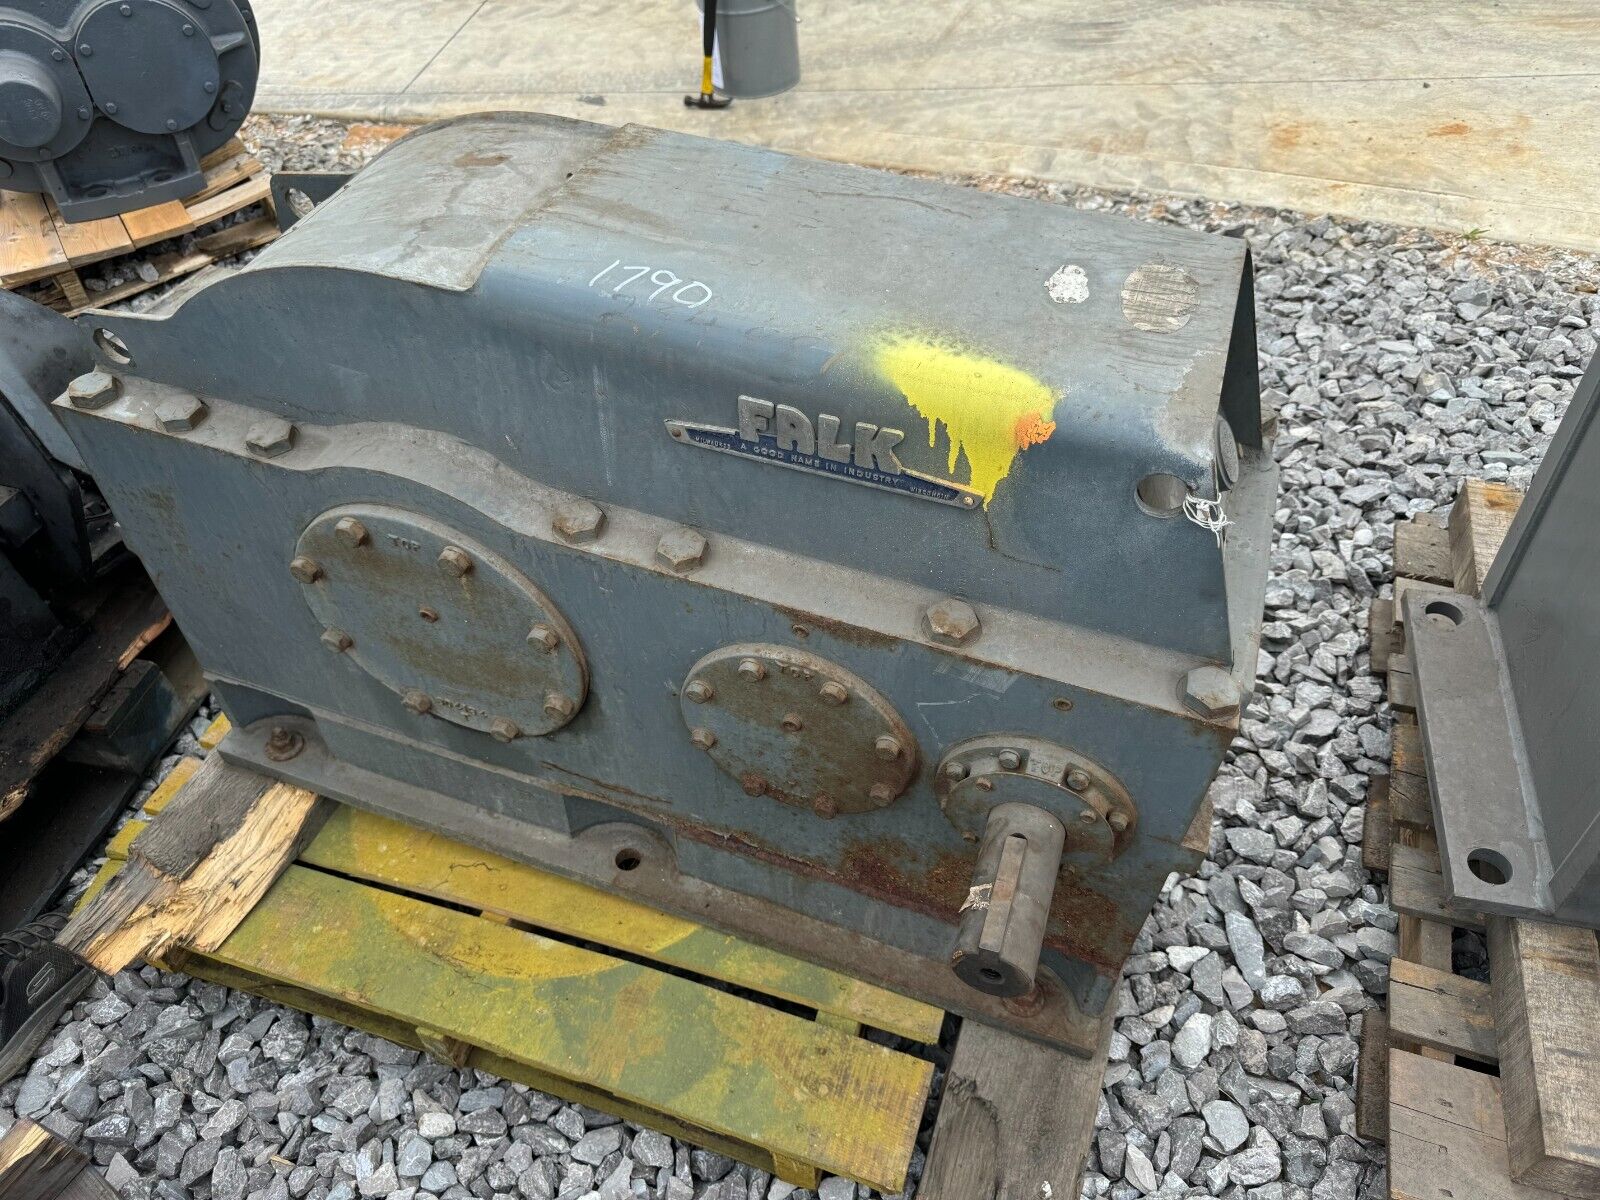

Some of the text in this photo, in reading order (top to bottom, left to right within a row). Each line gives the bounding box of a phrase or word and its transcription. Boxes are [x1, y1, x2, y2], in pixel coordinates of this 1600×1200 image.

[588, 259, 713, 309] 1790
[737, 394, 905, 476] FALK
[740, 442, 899, 487] A GOOD NAME IN INDUSTRY
